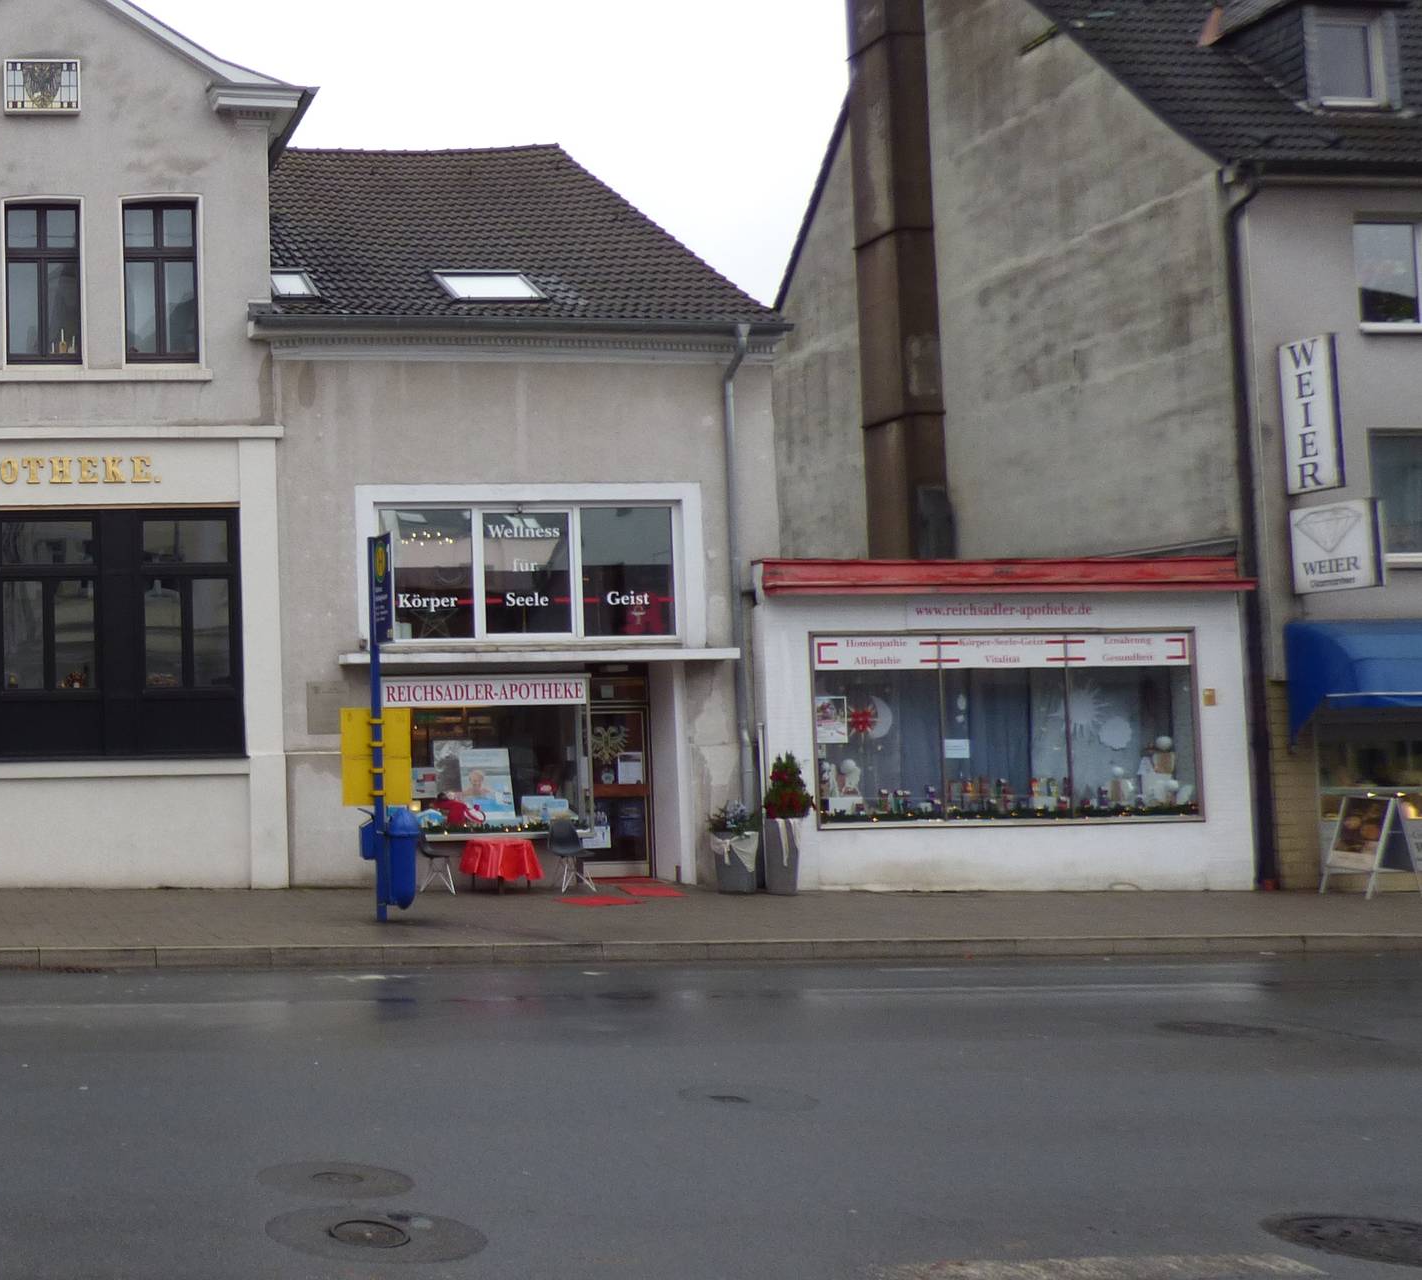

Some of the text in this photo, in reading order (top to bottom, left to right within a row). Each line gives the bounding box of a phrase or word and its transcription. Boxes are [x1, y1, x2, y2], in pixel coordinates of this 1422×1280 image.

[1287, 338, 1324, 489] WEIER
[488, 524, 561, 539] Wellness
[512, 557, 539, 573] für
[1302, 555, 1361, 577] WEIER
[398, 593, 459, 612] Körper
[505, 592, 549, 607] Seele
[606, 590, 651, 606] Geist
[915, 602, 1092, 620] www.reichsadler-apotheke.de
[846, 639, 907, 650] Homöopathie
[1103, 636, 1153, 646] Ernährung
[854, 656, 901, 667] Allopathie
[984, 655, 1020, 664] Vitalität
[1102, 653, 1154, 662] Gesundheit
[386, 682, 584, 703] REICHSADLER-APOTHEKE
